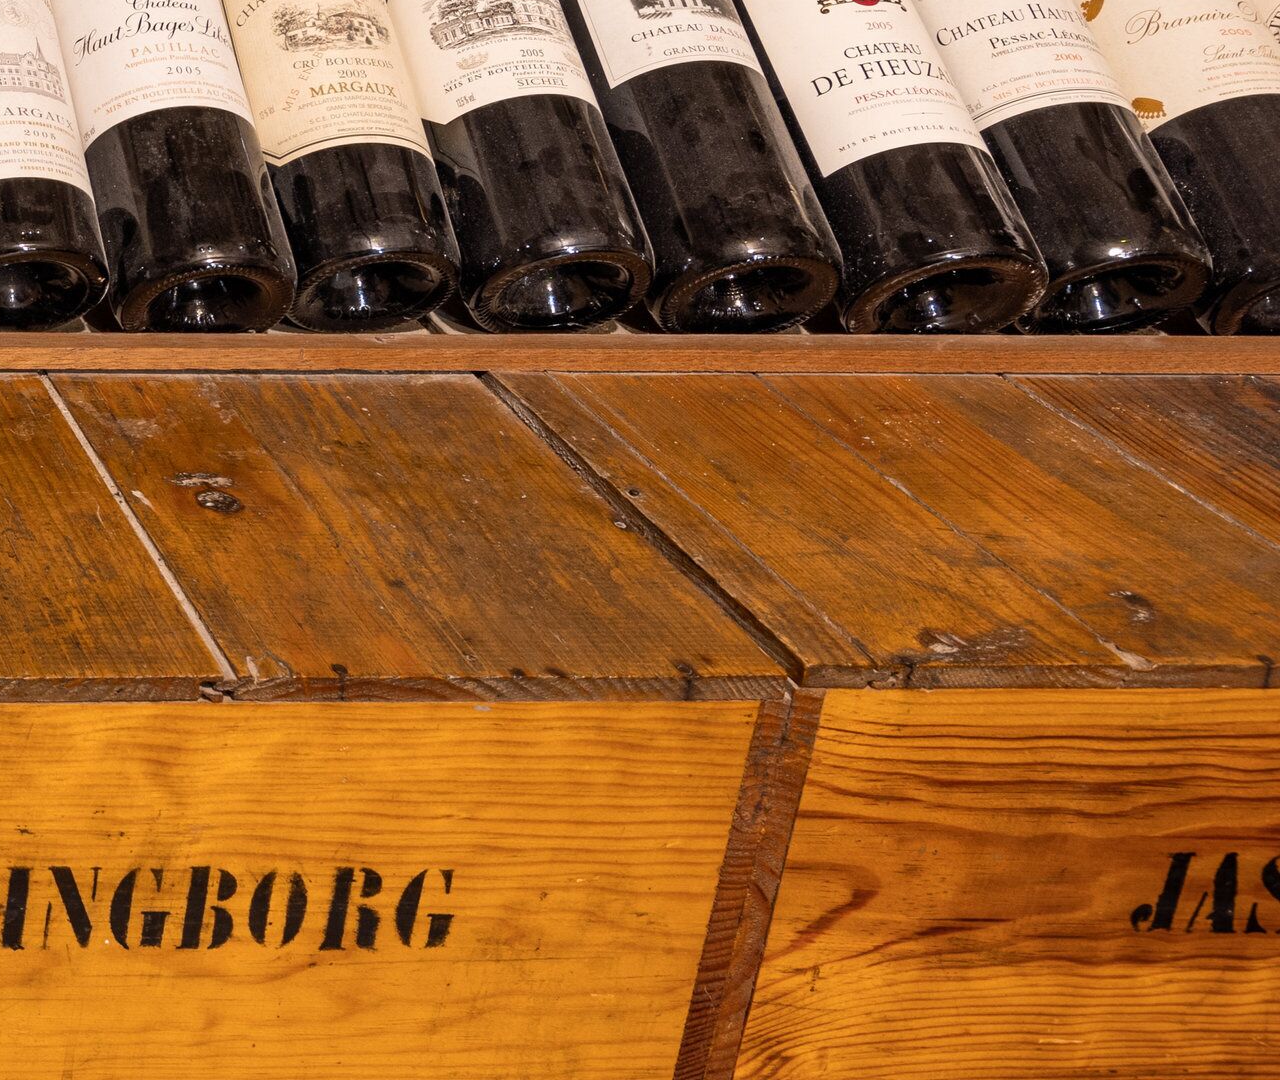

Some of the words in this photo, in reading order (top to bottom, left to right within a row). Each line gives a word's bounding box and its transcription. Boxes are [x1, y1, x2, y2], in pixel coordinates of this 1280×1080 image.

[865, 21, 893, 31] 2005
[936, 8, 1024, 46] CHATEAU
[631, 22, 704, 43] CHATEAU
[74, 13, 195, 66] Haut-Bages
[521, 49, 544, 57] 2005
[844, 42, 922, 59] CHATEAU
[1053, 52, 1083, 61] 2000
[167, 66, 201, 75] 2005
[338, 70, 367, 78] 2003
[517, 78, 567, 88] SICHEL
[810, 69, 854, 97] DE
[309, 83, 397, 98] MARGAUX
